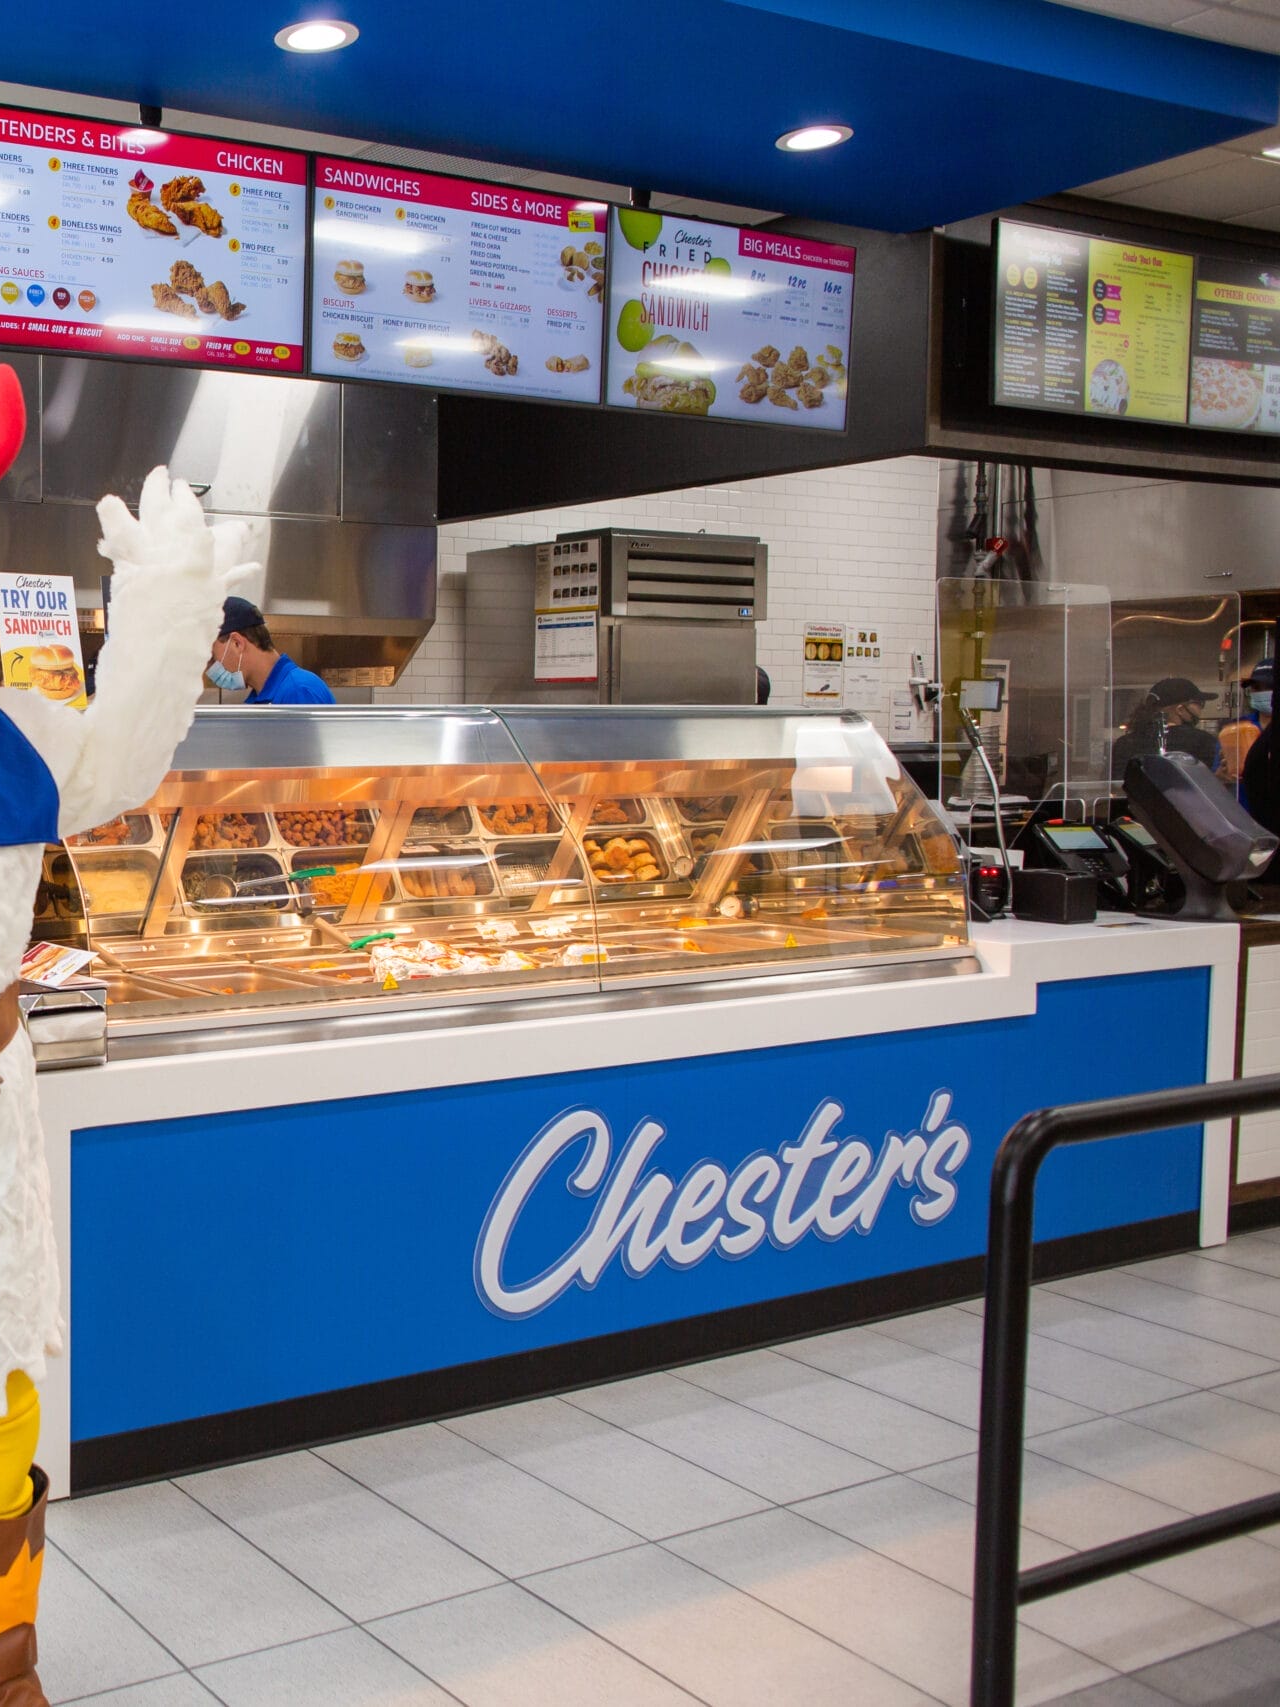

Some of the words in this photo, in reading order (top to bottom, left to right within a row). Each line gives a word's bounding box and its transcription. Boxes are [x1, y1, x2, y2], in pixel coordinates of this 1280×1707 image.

[81, 131, 95, 148] &
[100, 133, 146, 155] BITES
[62, 161, 86, 172] THREE
[87, 165, 119, 176] TENDERS
[217, 151, 284, 176] CHICKEN
[324, 167, 421, 197] SANDWICHES
[242, 187, 263, 197] THREE
[264, 190, 283, 200] PIECE
[335, 200, 354, 210] FRIED
[354, 203, 382, 214] CHICKEN
[471, 191, 508, 211] SIDES
[512, 198, 523, 213] &
[525, 200, 562, 220] MORE
[335, 209, 369, 220] SANDWICH
[406, 210, 420, 220] BBQ
[420, 214, 446, 224] CHICKEN
[61, 219, 98, 231] BONELESS
[99, 224, 122, 234] WINGS
[406, 220, 438, 231] SANDWICH
[470, 221, 488, 230] FRESH
[488, 224, 499, 232] CUT
[500, 226, 521, 235] WEDGES
[470, 231, 484, 239] MAC
[488, 234, 508, 243] CHEESE
[674, 229, 713, 248] Chester's
[241, 242, 256, 251] TWO
[256, 244, 275, 253] PIECE
[470, 241, 486, 250] FRIED
[643, 241, 712, 264] FRIED
[743, 237, 763, 254] BIG
[765, 241, 801, 260] MEALS
[802, 254, 823, 265] CHICKEN
[828, 258, 849, 268] TENDERS
[470, 250, 486, 259] FRIED
[12, 267, 46, 279] SAUCES
[470, 259, 492, 269] MASHED
[492, 262, 518, 273] POTATOES
[469, 268, 488, 277] GREEN
[488, 271, 506, 280] BEANS
[787, 275, 798, 289] 12
[798, 279, 807, 289] PC
[823, 281, 833, 294] 16
[833, 284, 843, 295] PC
[1214, 287, 1244, 300] OTHER
[323, 297, 355, 309] BISCUITS
[468, 298, 491, 308] LIVERS
[499, 302, 532, 313] GIZZARDS
[322, 311, 350, 321] CHICKEN
[350, 314, 374, 324] BISCUIT
[547, 308, 578, 319] DESSERTS
[640, 292, 709, 333] SANDWICH
[21, 322, 26, 330] 1
[27, 323, 50, 333] SMALL
[51, 325, 67, 334] SIDE
[75, 327, 104, 338] BISCUIT
[382, 318, 403, 327] HONEY
[404, 320, 427, 330] BUTTER
[427, 324, 451, 333] BISCUIT
[546, 319, 562, 329] FRIED
[562, 321, 572, 330] PIE
[205, 341, 222, 350] FRIED
[222, 343, 232, 351] PIE
[15, 575, 53, 589] Chester's
[0, 588, 30, 609] TRY
[36, 591, 68, 611] OUR
[4, 618, 72, 636] SANDWICH
[480, 1092, 970, 1314] Chester's
